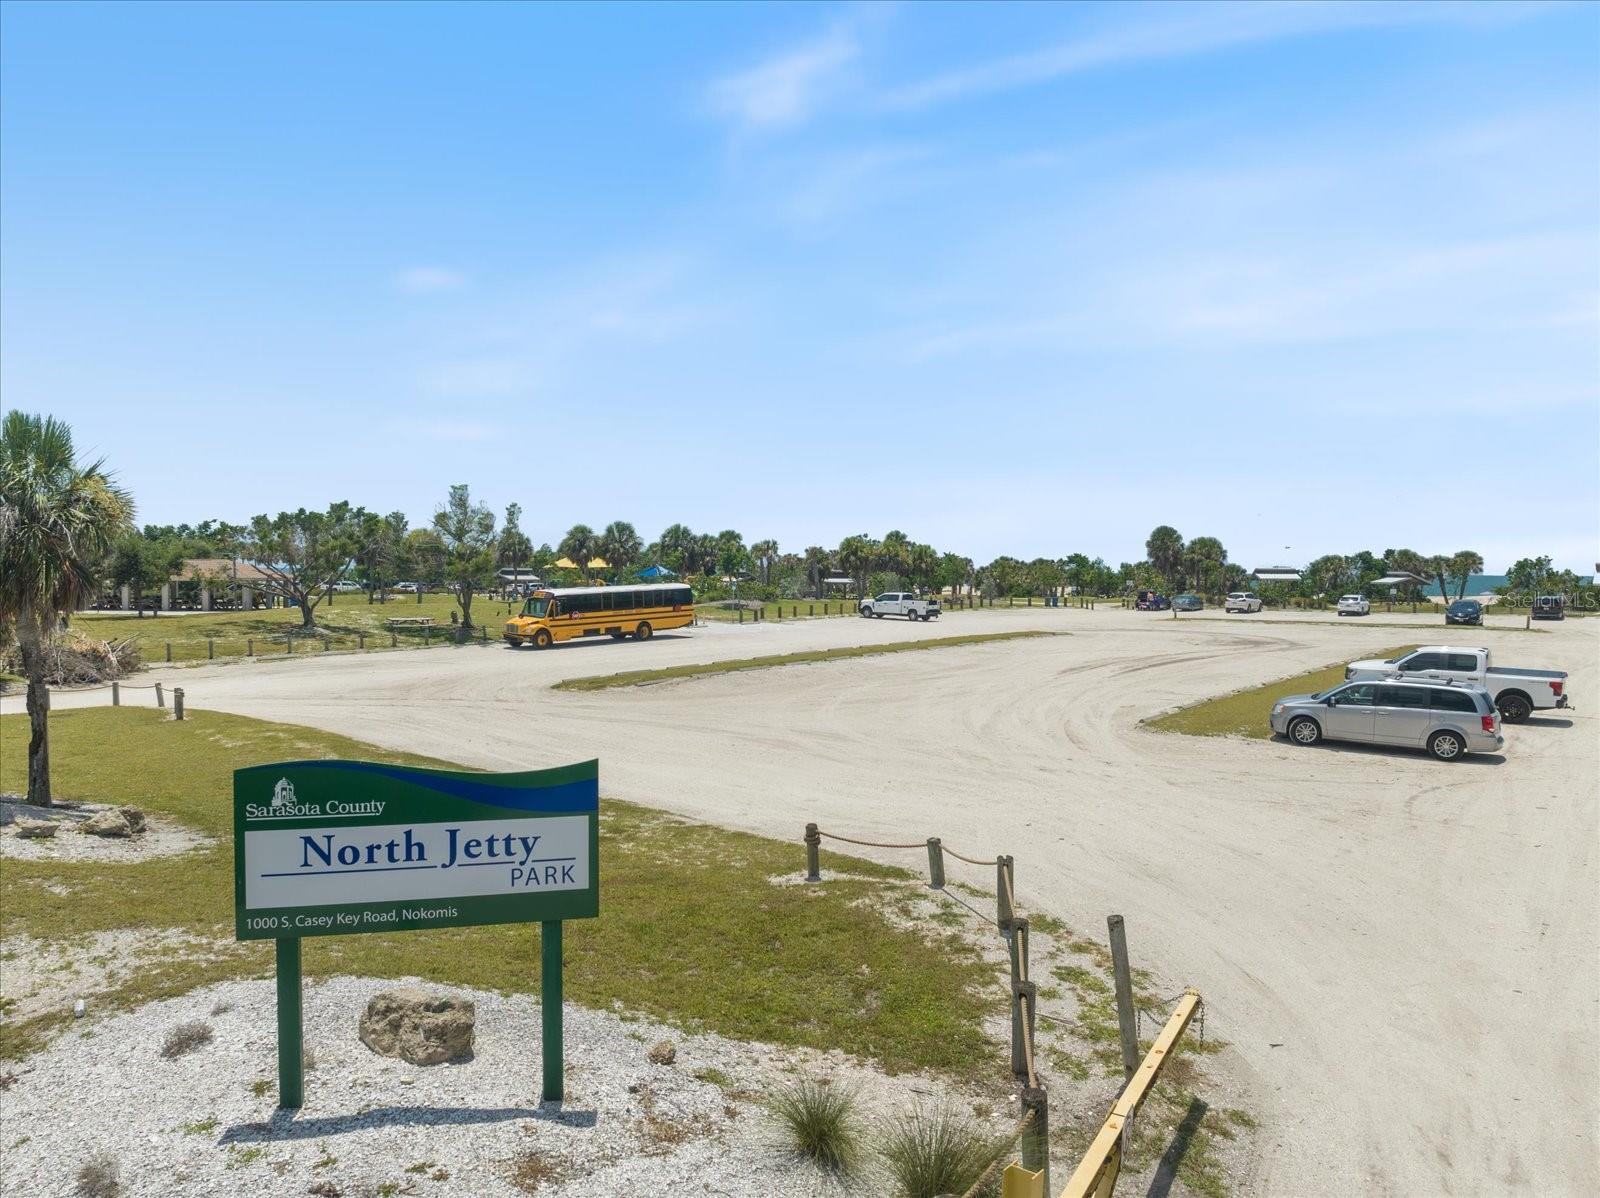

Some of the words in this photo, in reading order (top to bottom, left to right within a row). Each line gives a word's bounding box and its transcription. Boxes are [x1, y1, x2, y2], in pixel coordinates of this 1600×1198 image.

[245, 802, 321, 818] Sarasota
[325, 800, 386, 816] County
[300, 829, 428, 868] North
[441, 828, 542, 869] Jetty
[511, 864, 576, 887] PARK
[246, 917, 278, 930] 1000
[295, 914, 334, 928] Casey
[337, 911, 360, 925] Key
[363, 910, 400, 923] Road,
[402, 906, 459, 920] Nokomis
